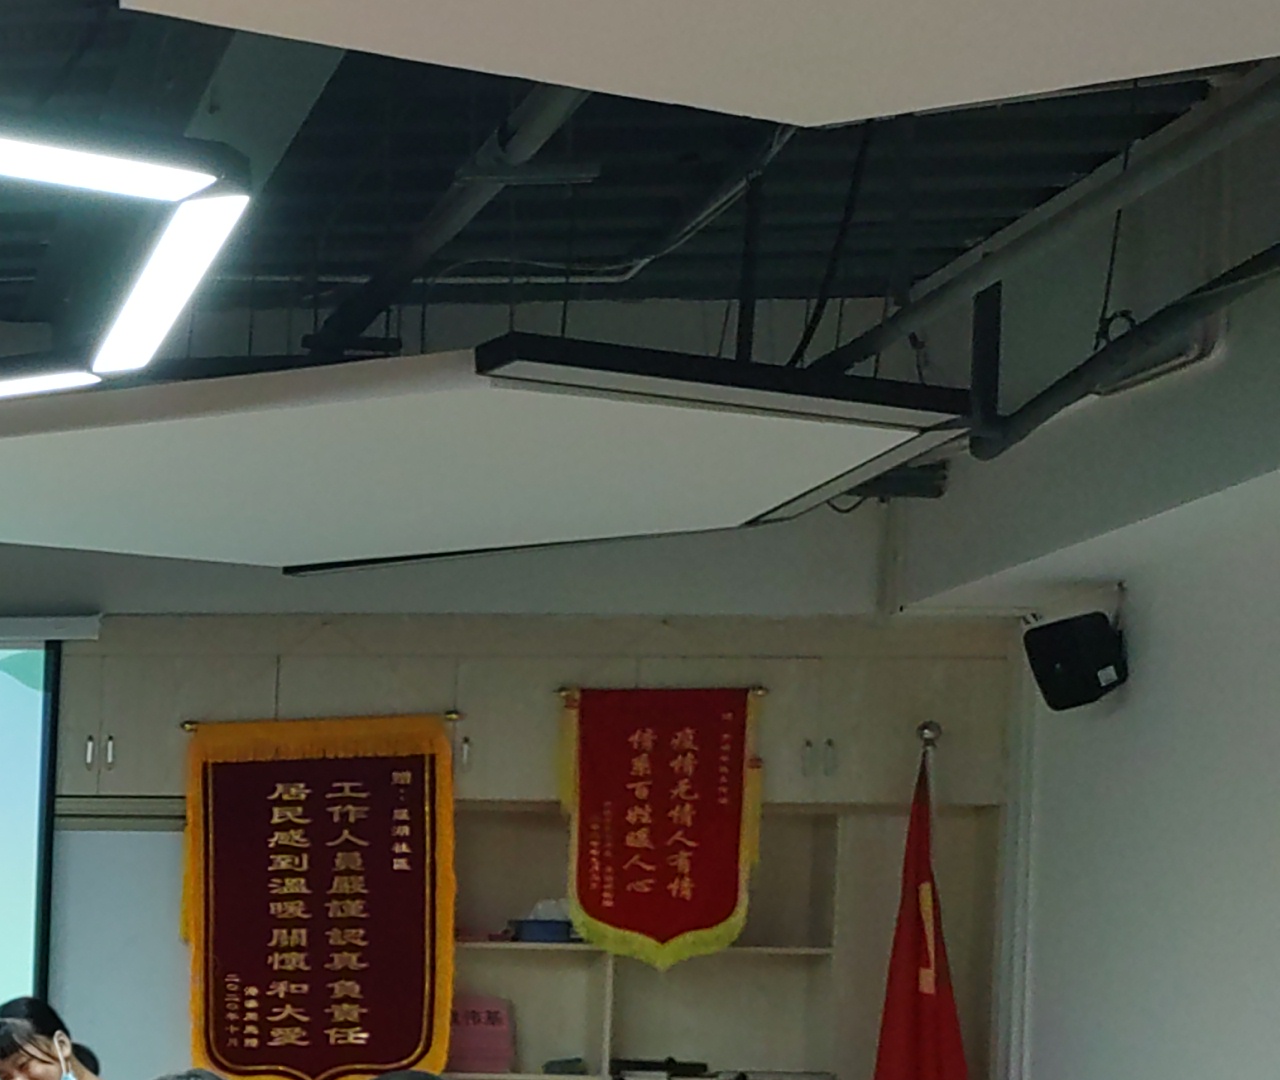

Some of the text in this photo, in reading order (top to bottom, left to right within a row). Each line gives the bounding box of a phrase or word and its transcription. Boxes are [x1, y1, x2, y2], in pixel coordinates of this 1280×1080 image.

[324, 781, 369, 1045] 工作人員嚴謹認真負責任
